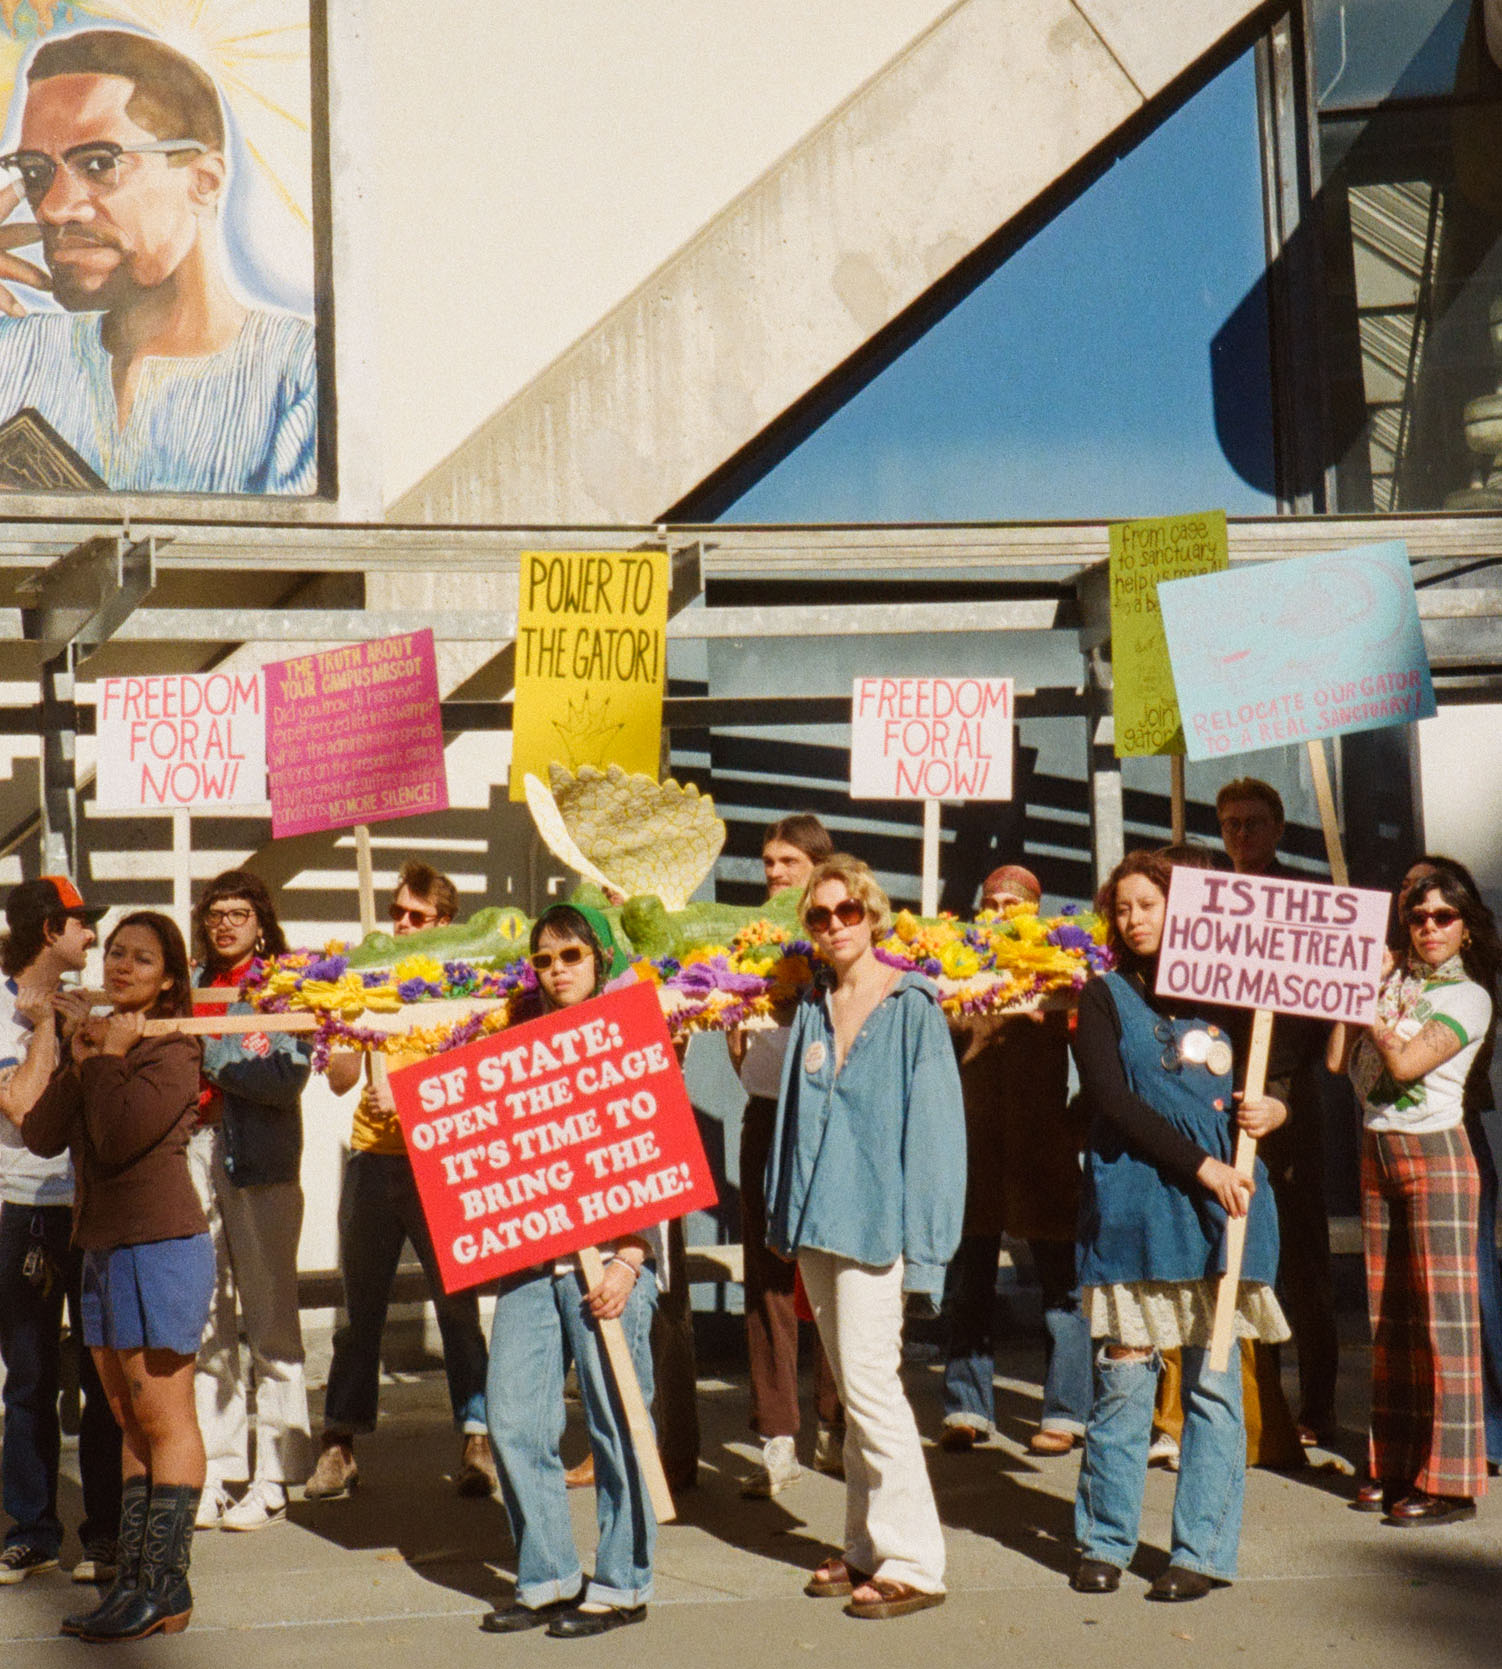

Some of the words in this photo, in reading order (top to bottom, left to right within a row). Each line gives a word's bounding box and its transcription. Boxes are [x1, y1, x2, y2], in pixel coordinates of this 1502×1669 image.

[1118, 552, 1135, 571] to
[1140, 541, 1217, 567] sanctuary
[529, 557, 613, 614] POWER
[619, 558, 653, 616] TO
[1114, 569, 1147, 595] help
[285, 657, 313, 680] THE
[318, 648, 361, 673] TRUTH
[366, 637, 413, 662] ABOUT
[521, 627, 567, 678] THE
[572, 628, 659, 684] GATOR!
[103, 673, 261, 720] FREEDOM
[280, 676, 316, 702] YOUR
[321, 668, 370, 694] CAMPUS
[371, 658, 423, 683] MASCOT
[859, 679, 1008, 719] FREEDOM
[1192, 694, 1304, 737] RELOCATE
[1313, 682, 1357, 707] OUR
[1359, 669, 1422, 698] GATOR
[274, 704, 295, 724] Did
[1204, 734, 1231, 754] TO
[1240, 728, 1254, 748] A
[1260, 722, 1310, 745] REAL
[1316, 691, 1422, 731] SANCTUARY!
[129, 717, 198, 761] FOR
[203, 717, 246, 760] AL
[884, 719, 949, 759] FOR
[954, 719, 992, 759] AL
[141, 761, 239, 804] NOW!
[895, 758, 990, 796] NOW!
[329, 800, 345, 817] NO
[347, 794, 377, 813] MORE
[1201, 877, 1256, 917] IS
[1260, 885, 1359, 925] THIS
[1168, 915, 1241, 956] HOW
[1244, 922, 1286, 962] WE
[1287, 927, 1376, 972] TREAT
[1167, 959, 1233, 1000] OUR
[1235, 968, 1376, 1017] MASCOT?
[418, 1066, 468, 1113] SF
[477, 1018, 624, 1093] STATE:
[410, 1100, 499, 1151] OPEN
[505, 1076, 574, 1120] THE
[576, 1043, 670, 1095] CAGE
[440, 1139, 510, 1185] IT'S
[512, 1109, 602, 1161] TIME
[606, 1091, 657, 1129] TO
[459, 1161, 575, 1221] BRING
[585, 1131, 661, 1179] THE
[451, 1203, 574, 1265] GATOR
[577, 1163, 693, 1224] HOME!
